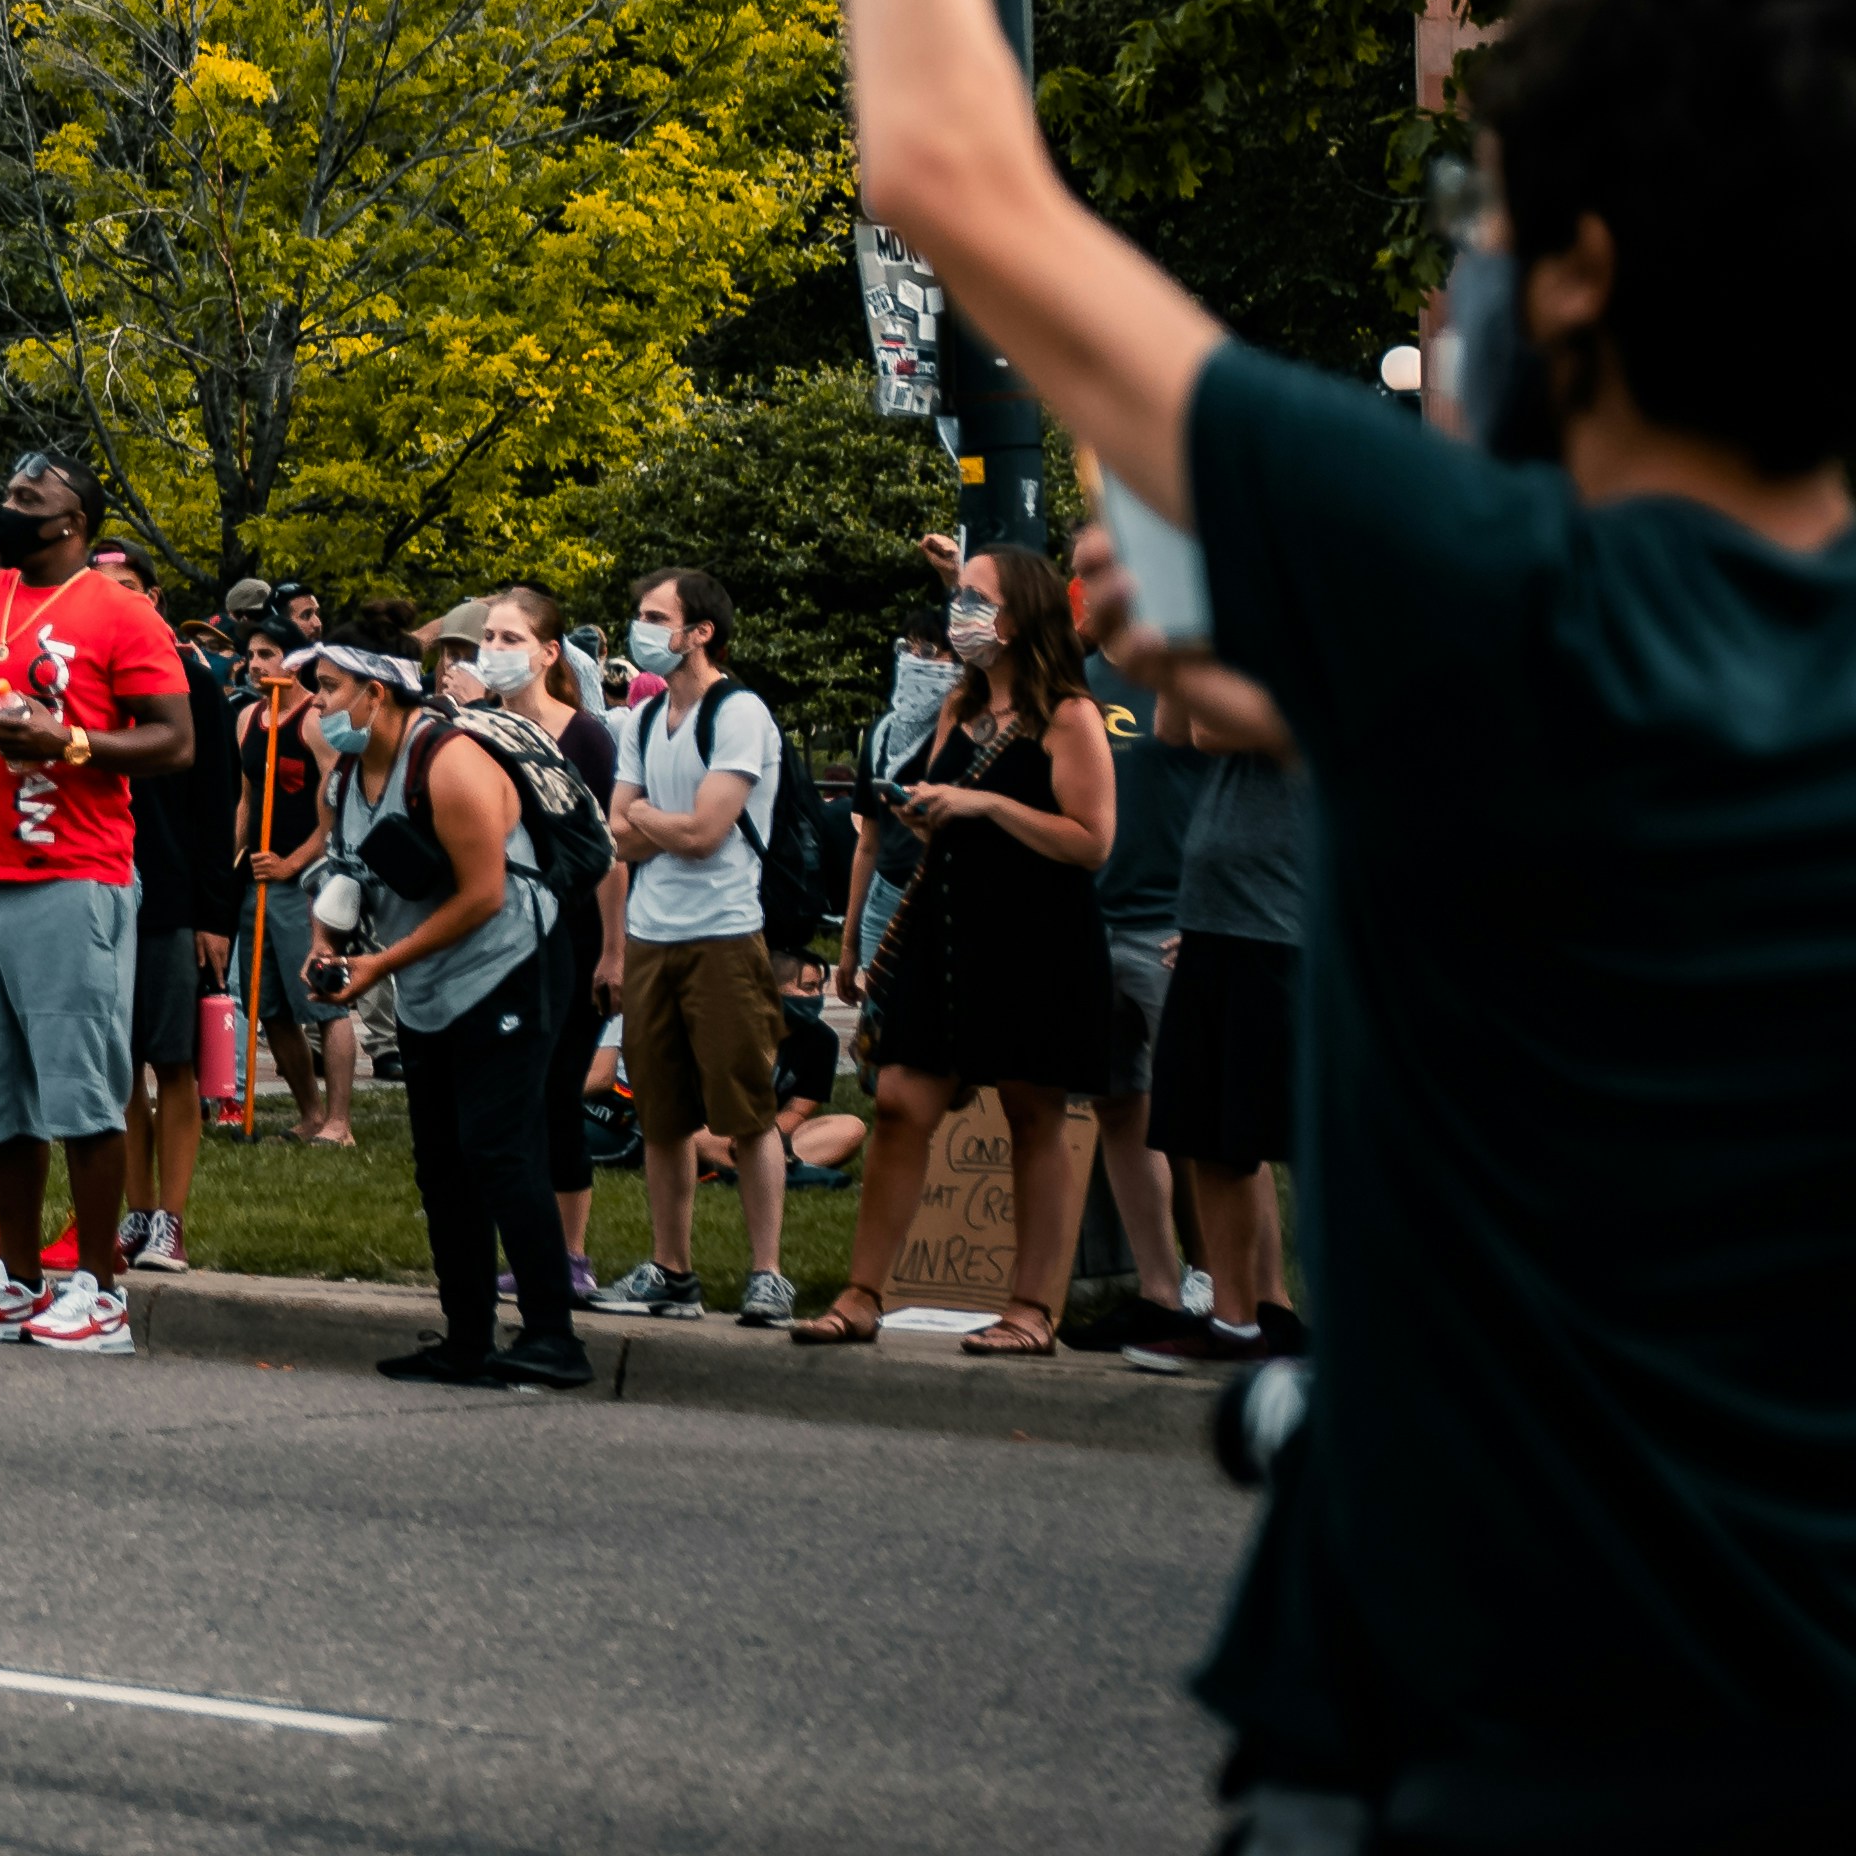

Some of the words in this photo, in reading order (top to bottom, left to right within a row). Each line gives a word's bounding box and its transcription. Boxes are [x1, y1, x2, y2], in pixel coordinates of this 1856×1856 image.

[14, 622, 76, 844] JOAN
[945, 1117, 1013, 1172] COND
[964, 1173, 1015, 1231] CRE
